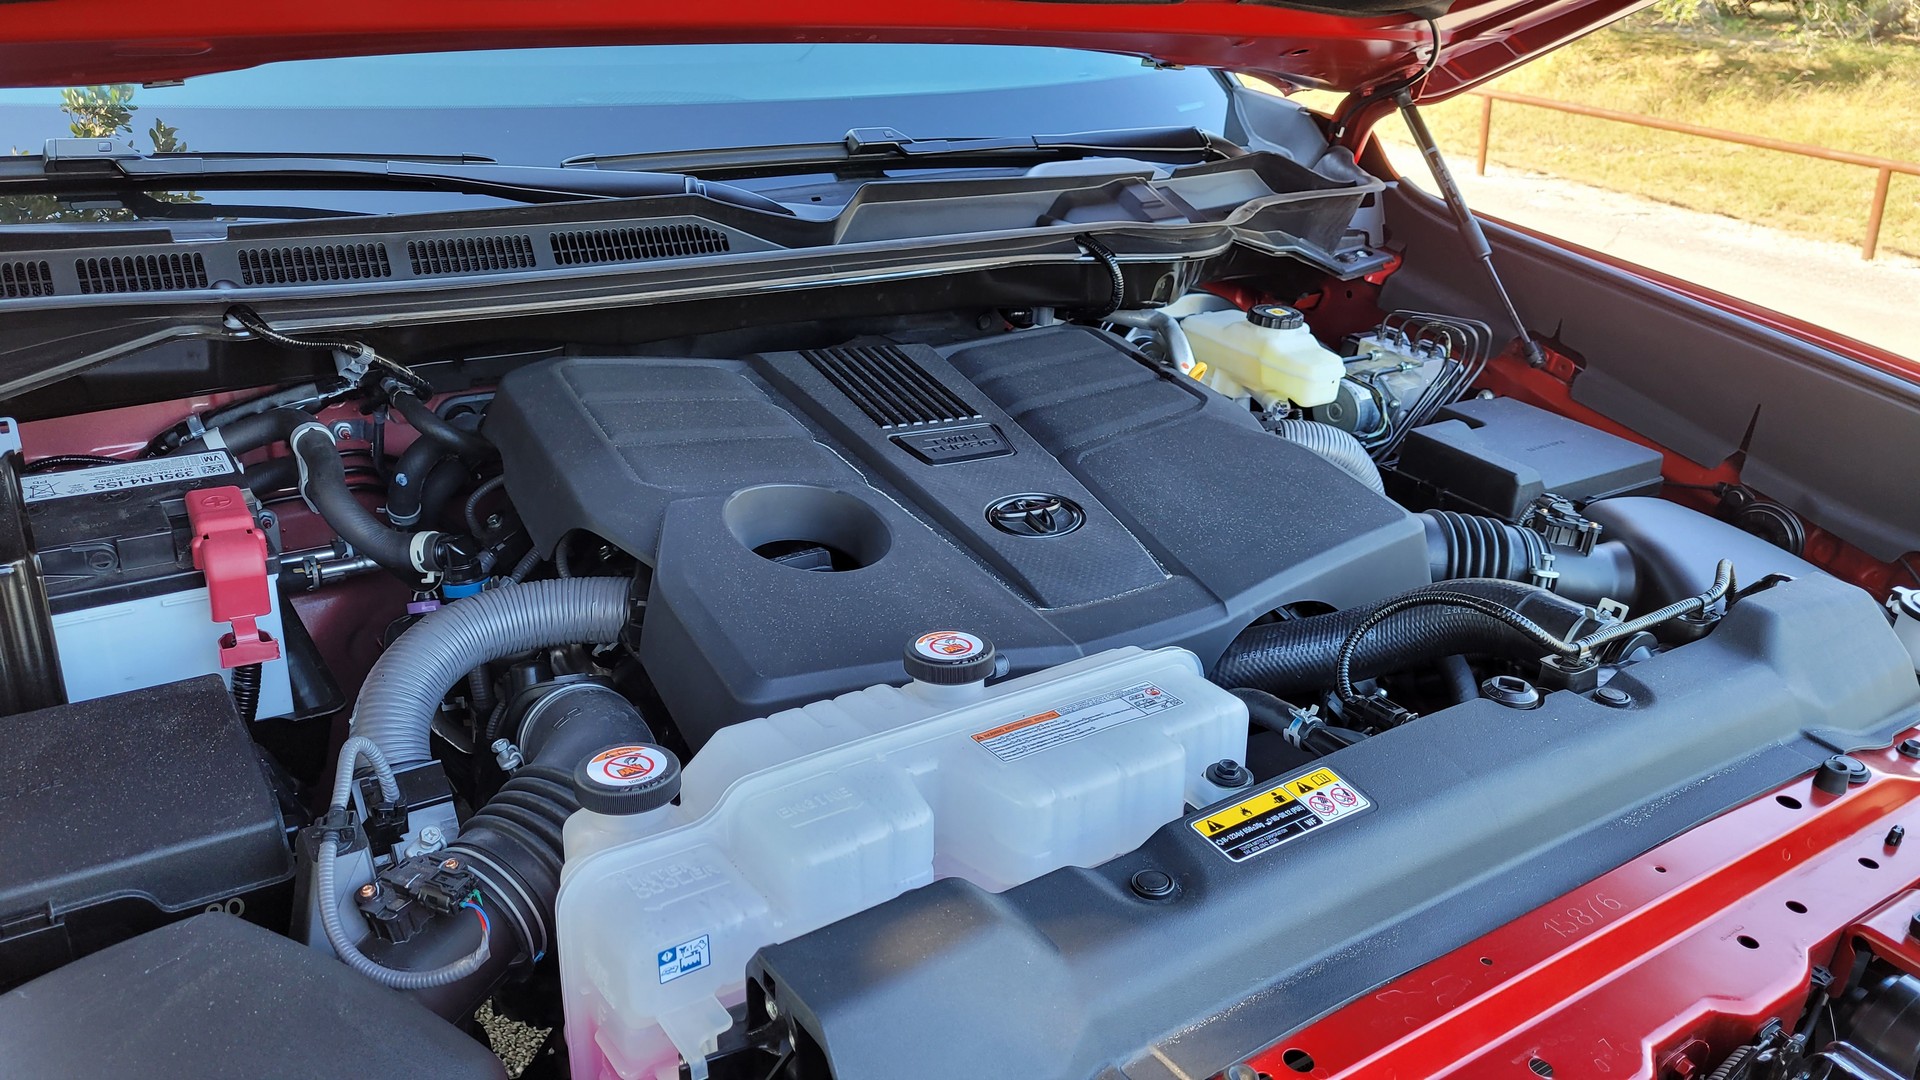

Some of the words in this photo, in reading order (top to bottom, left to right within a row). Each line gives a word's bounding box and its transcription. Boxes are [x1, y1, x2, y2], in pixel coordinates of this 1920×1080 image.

[922, 438, 998, 453] TURBO
[203, 455, 221, 463] VM
[93, 470, 195, 490] 395LN4-ISS
[776, 786, 853, 819] ENGINE
[1303, 817, 1317, 826] WF
[635, 865, 720, 899] COOLER
